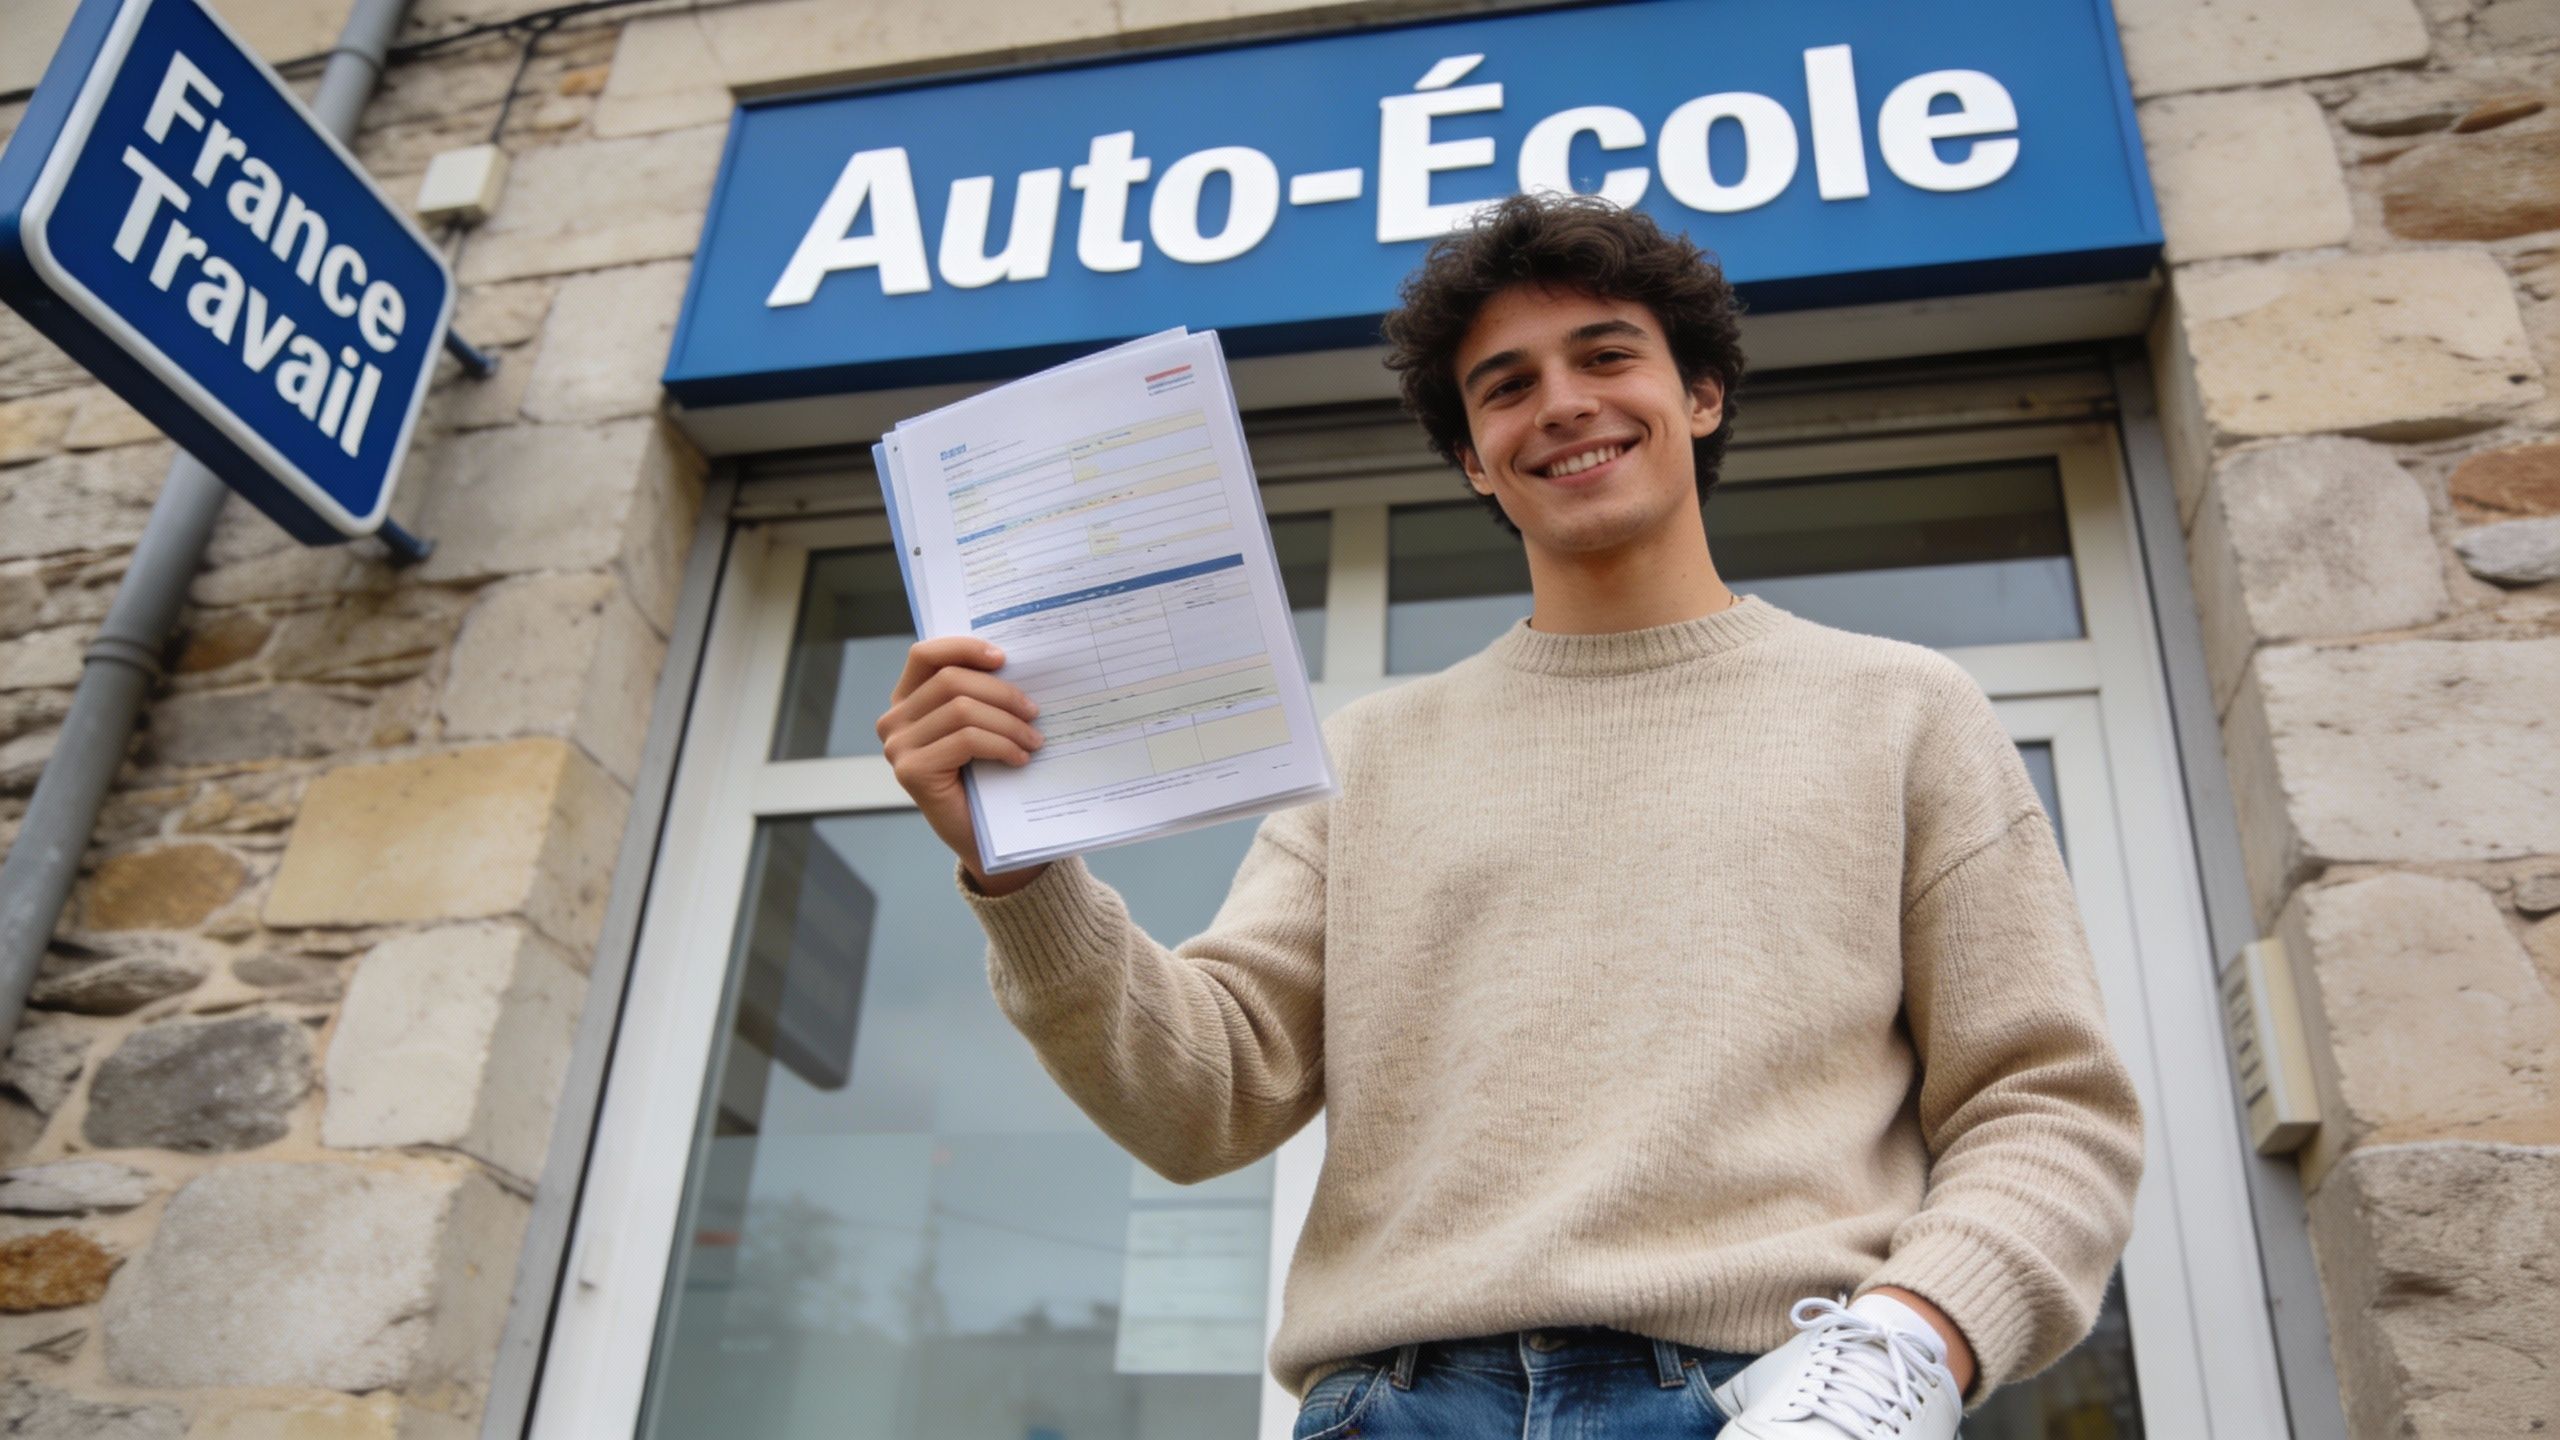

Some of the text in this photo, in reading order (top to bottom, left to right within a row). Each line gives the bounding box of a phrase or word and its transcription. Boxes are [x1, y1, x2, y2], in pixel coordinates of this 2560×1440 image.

[112, 145, 382, 458] Travail
[143, 50, 406, 353] France
[767, 45, 2020, 307] Auto-École
